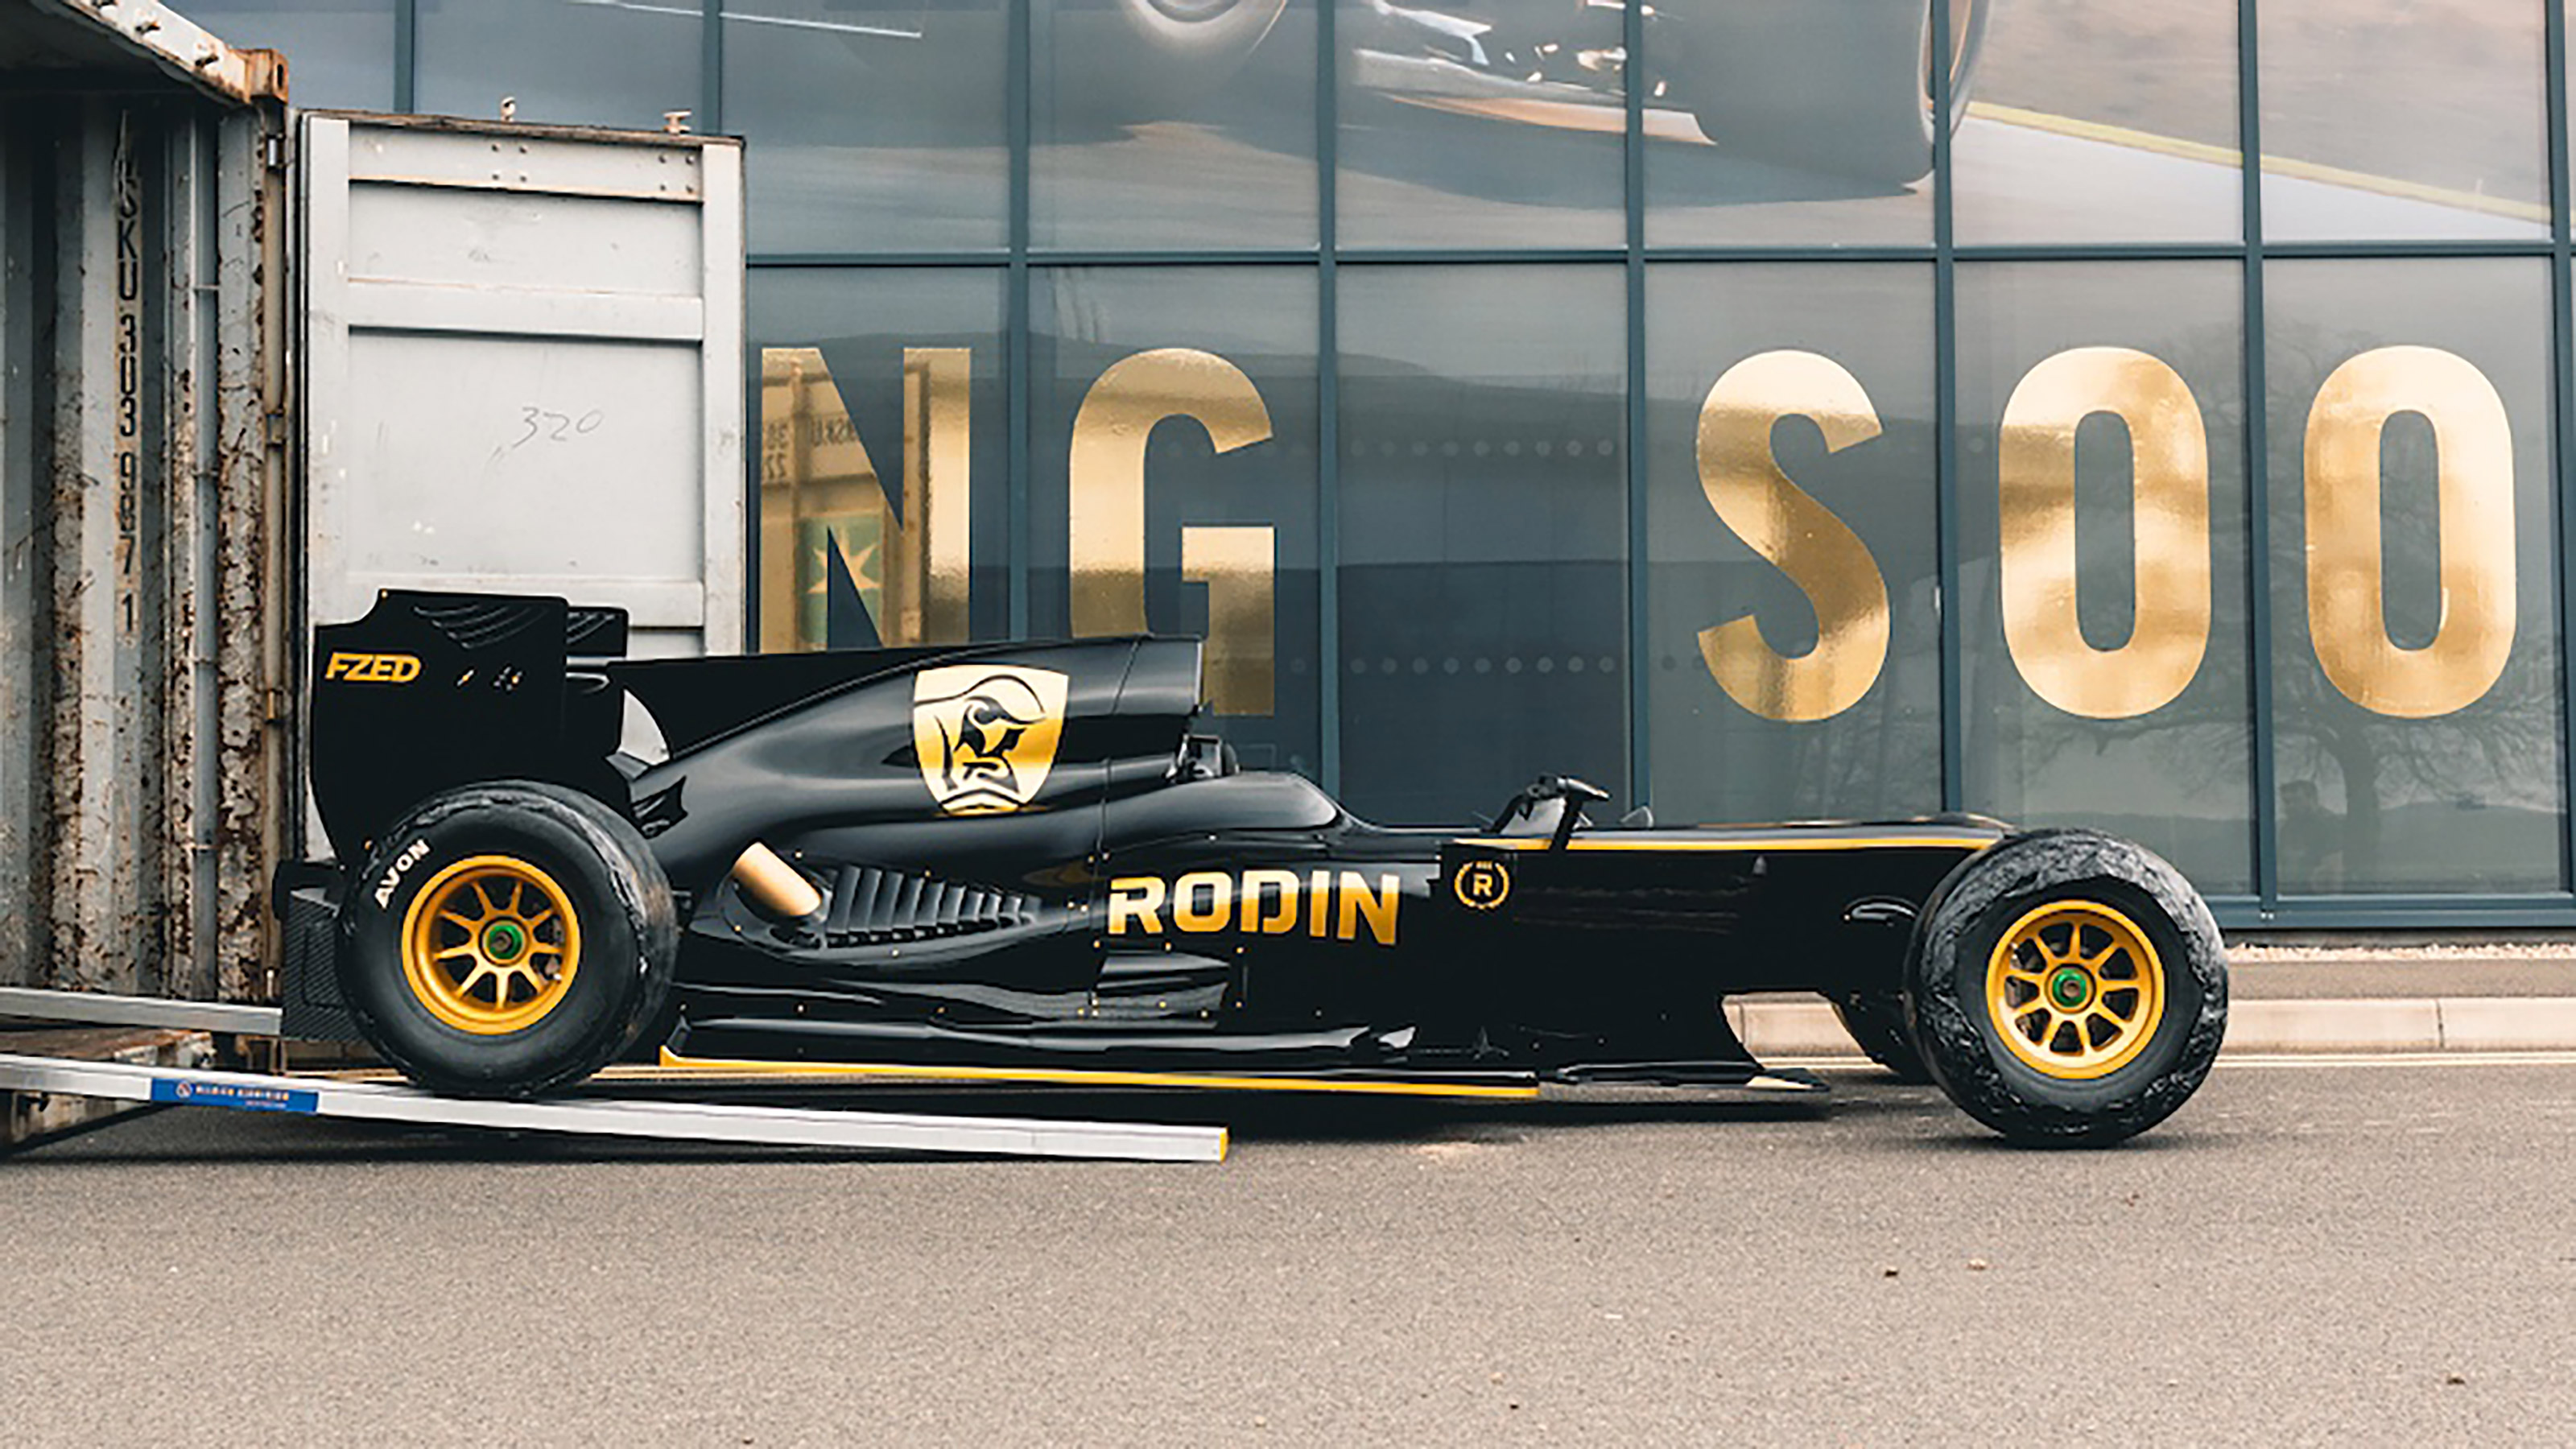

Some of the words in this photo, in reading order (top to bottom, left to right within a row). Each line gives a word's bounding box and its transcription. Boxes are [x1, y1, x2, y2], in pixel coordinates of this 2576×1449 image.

[119, 157, 138, 301] SKU
[511, 406, 605, 449] 320
[1695, 345, 2517, 722] SOO
[121, 592, 133, 632] 1
[324, 652, 422, 683] FZED
[374, 839, 430, 909] AVON
[1472, 873, 1493, 898] R
[1107, 869, 1401, 947] RODIN
